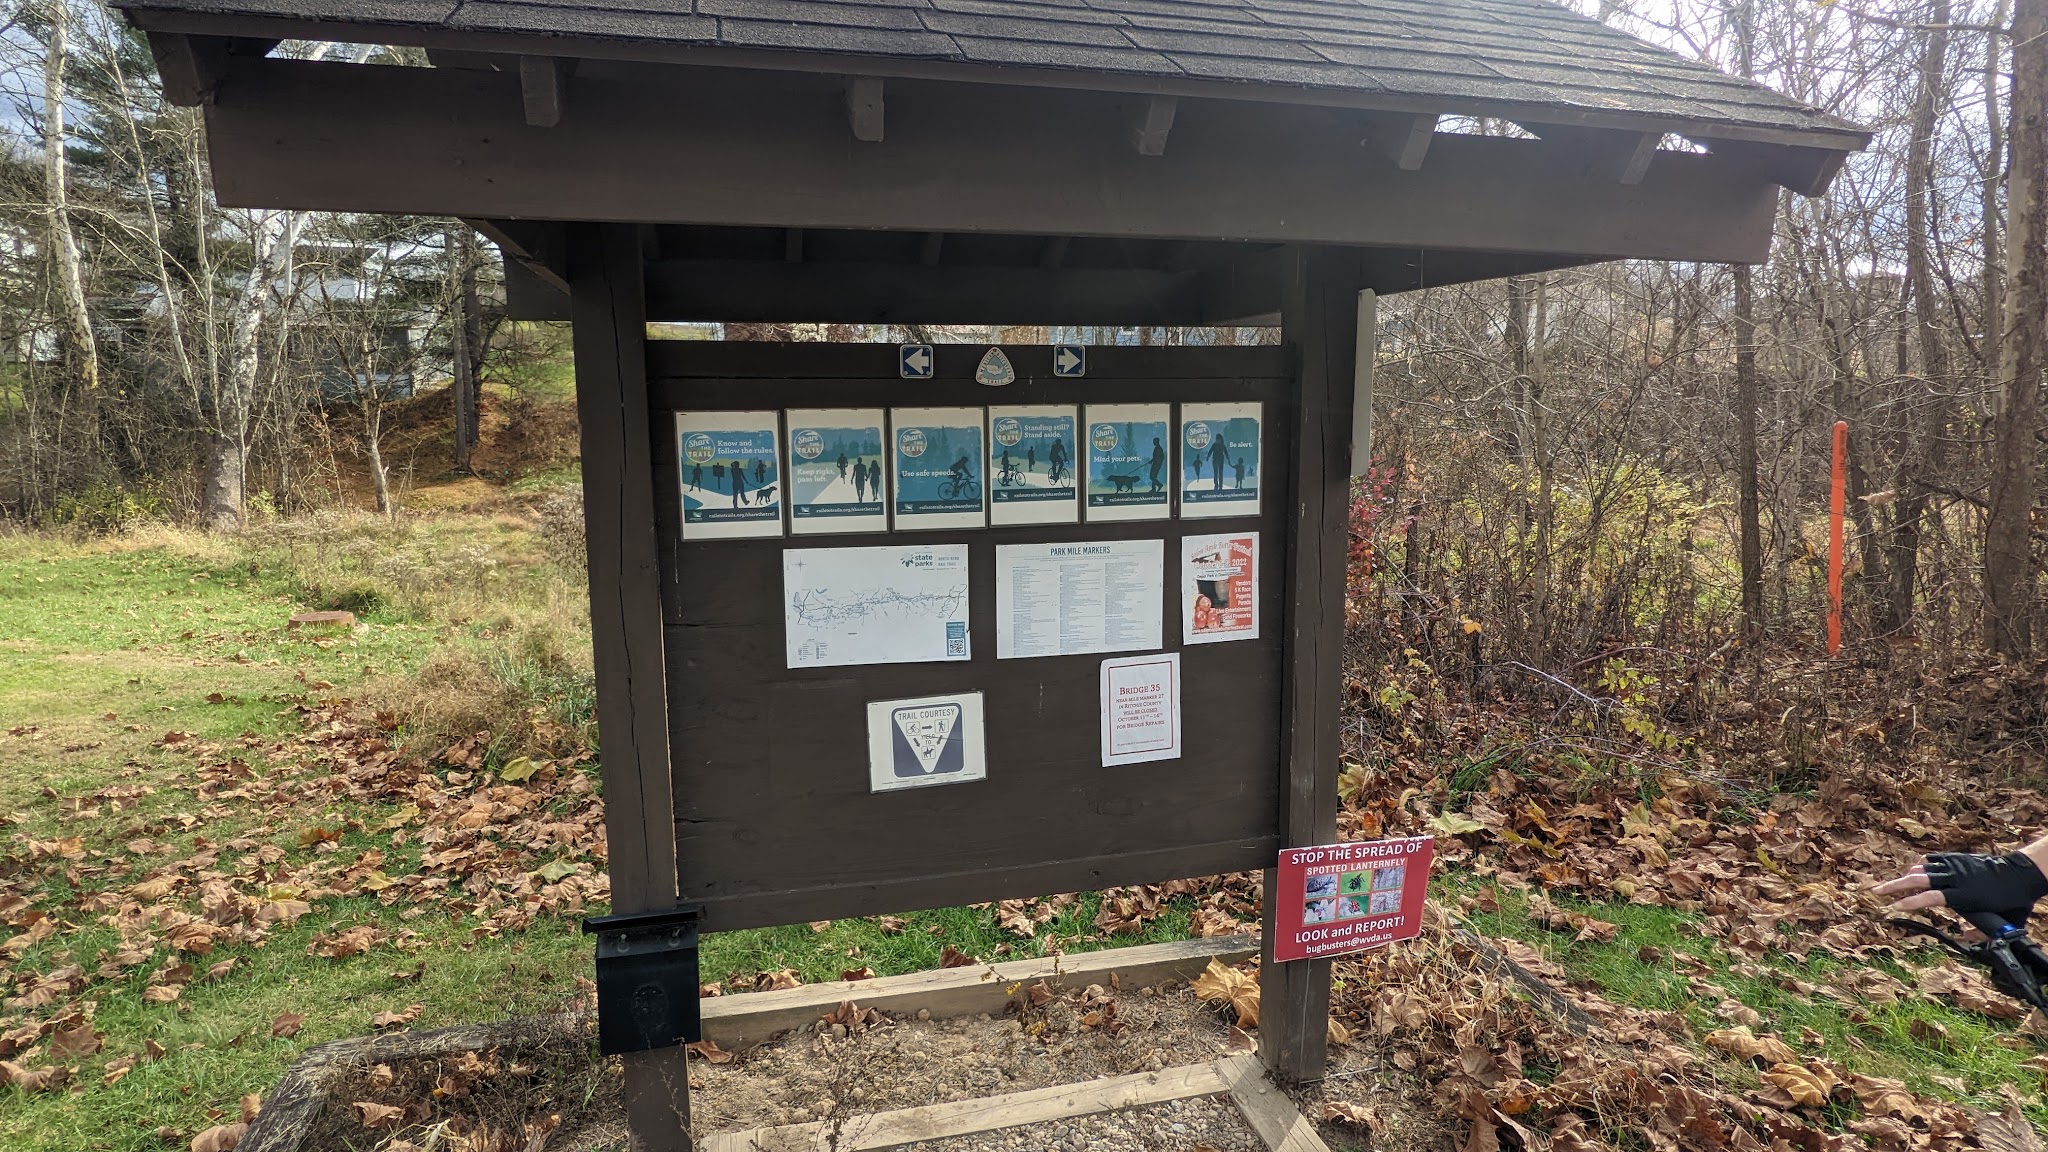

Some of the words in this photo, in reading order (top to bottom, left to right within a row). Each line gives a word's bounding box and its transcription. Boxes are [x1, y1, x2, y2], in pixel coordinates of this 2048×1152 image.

[999, 423, 1018, 432] Share
[1189, 427, 1207, 436] Share
[903, 433, 923, 443] Share
[1095, 428, 1114, 438] Share
[688, 439, 710, 448] Share
[798, 435, 819, 445] Share
[717, 447, 740, 455] follow
[797, 468, 815, 476] Keep
[815, 467, 835, 476] right,
[931, 469, 956, 478] speeds.
[797, 476, 813, 484] pass
[1050, 548, 1067, 556] PARK
[1067, 547, 1082, 555] MILE
[1083, 546, 1111, 555] MARKERS
[1231, 558, 1247, 566] 2022
[1119, 686, 1149, 695] BRIDGE
[1150, 684, 1161, 692] 35
[898, 712, 918, 721] TRAIL
[920, 708, 955, 719] COURTESY
[1291, 851, 1325, 865] STOP
[1328, 848, 1351, 860] THE
[1355, 844, 1404, 859] SPREAD
[1406, 841, 1423, 854] OF
[1306, 864, 1347, 876] SPOTTED
[1350, 857, 1406, 871] LANTERNFLY
[1295, 928, 1329, 944] LOOK
[1331, 924, 1352, 937] and
[1355, 915, 1405, 934] REPORT!
[1306, 932, 1393, 954] bugbusters@wvda.us
